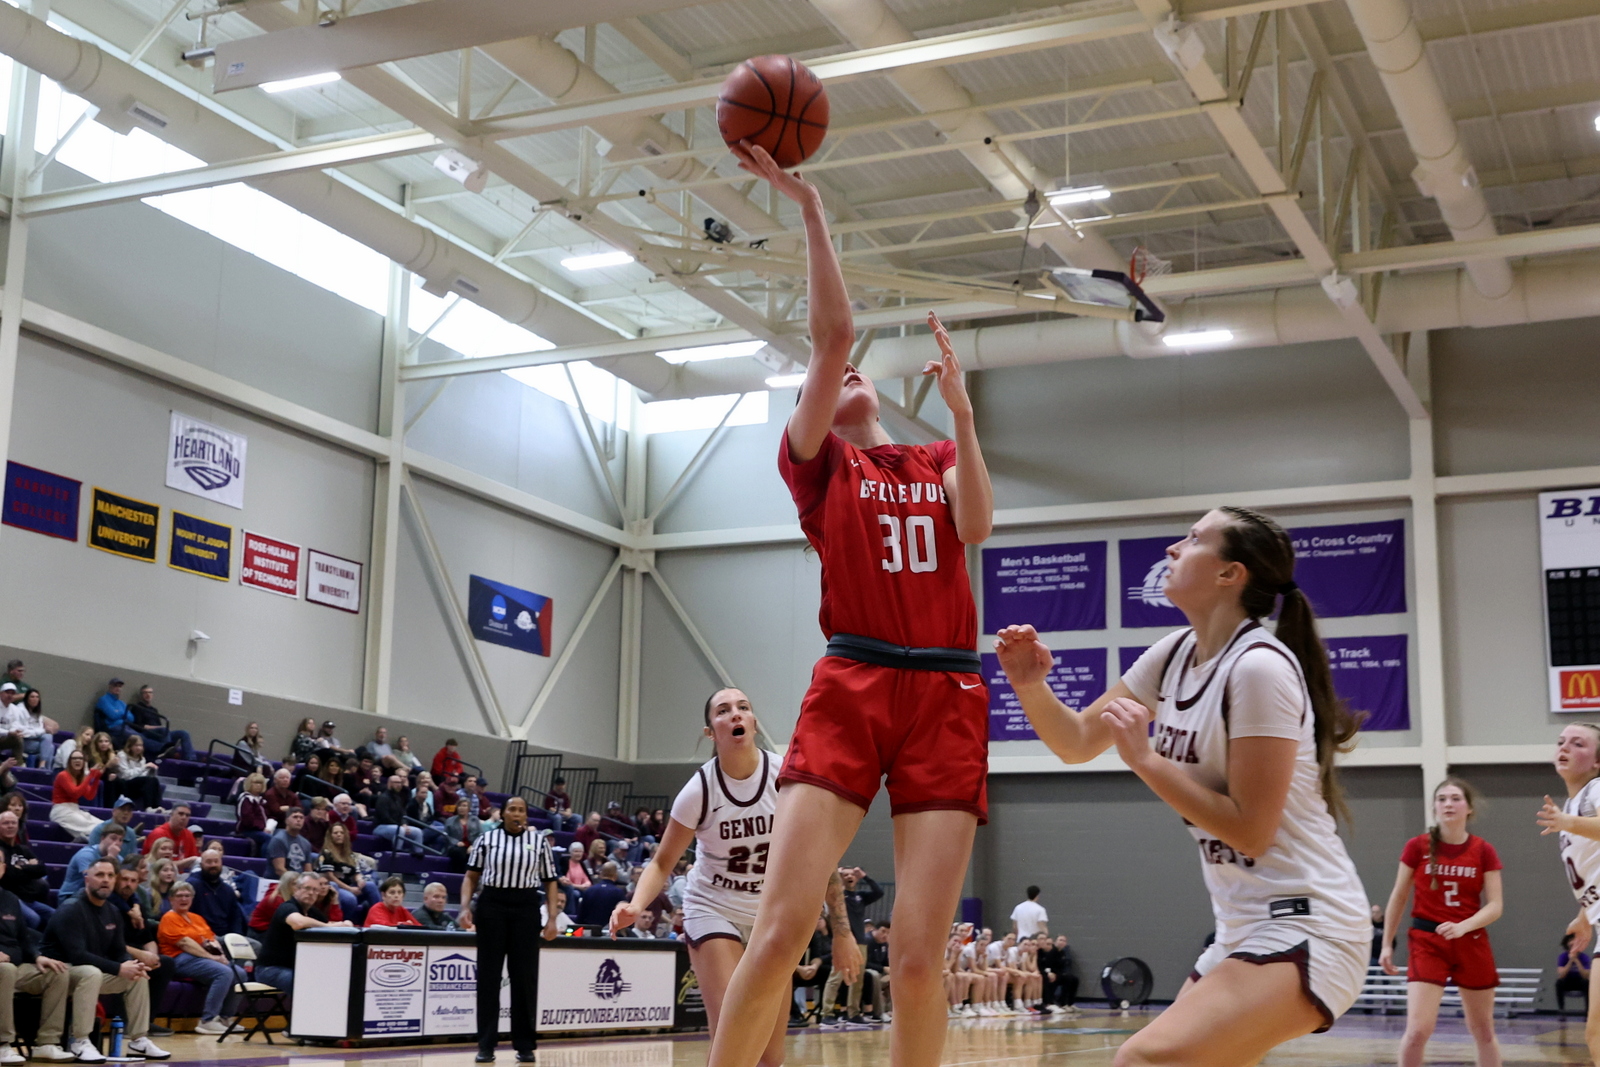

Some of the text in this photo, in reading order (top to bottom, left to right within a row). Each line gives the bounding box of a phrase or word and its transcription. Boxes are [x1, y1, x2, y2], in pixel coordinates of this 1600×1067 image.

[174, 435, 240, 479] HEARTLAND
[96, 499, 155, 526] MANCHESTER
[97, 525, 150, 549] UNIVERSITY
[176, 527, 197, 542] MOUNT
[1311, 537, 1345, 547] Cross
[1347, 533, 1394, 545] Country
[184, 545, 218, 561] UNIVERSITY
[248, 539, 296, 561] ROSE-HULMAN
[877, 514, 938, 574] 30
[253, 556, 289, 574] INSTITUTE
[1001, 553, 1086, 567] Men's Basketball
[242, 567, 297, 590] OF TECHNOLOGY
[315, 561, 355, 580] TRANSYLVANIA
[319, 584, 350, 600] UNIVERSITY
[1338, 647, 1371, 658] Track
[712, 873, 764, 893] COME
[1443, 881, 1460, 907] 2
[367, 948, 424, 962] Interdyne
[429, 964, 477, 981] STOLLY
[432, 1005, 474, 1015] Auto-Owners
[540, 1006, 671, 1025] BLUFFTONBEAVERS.COM
